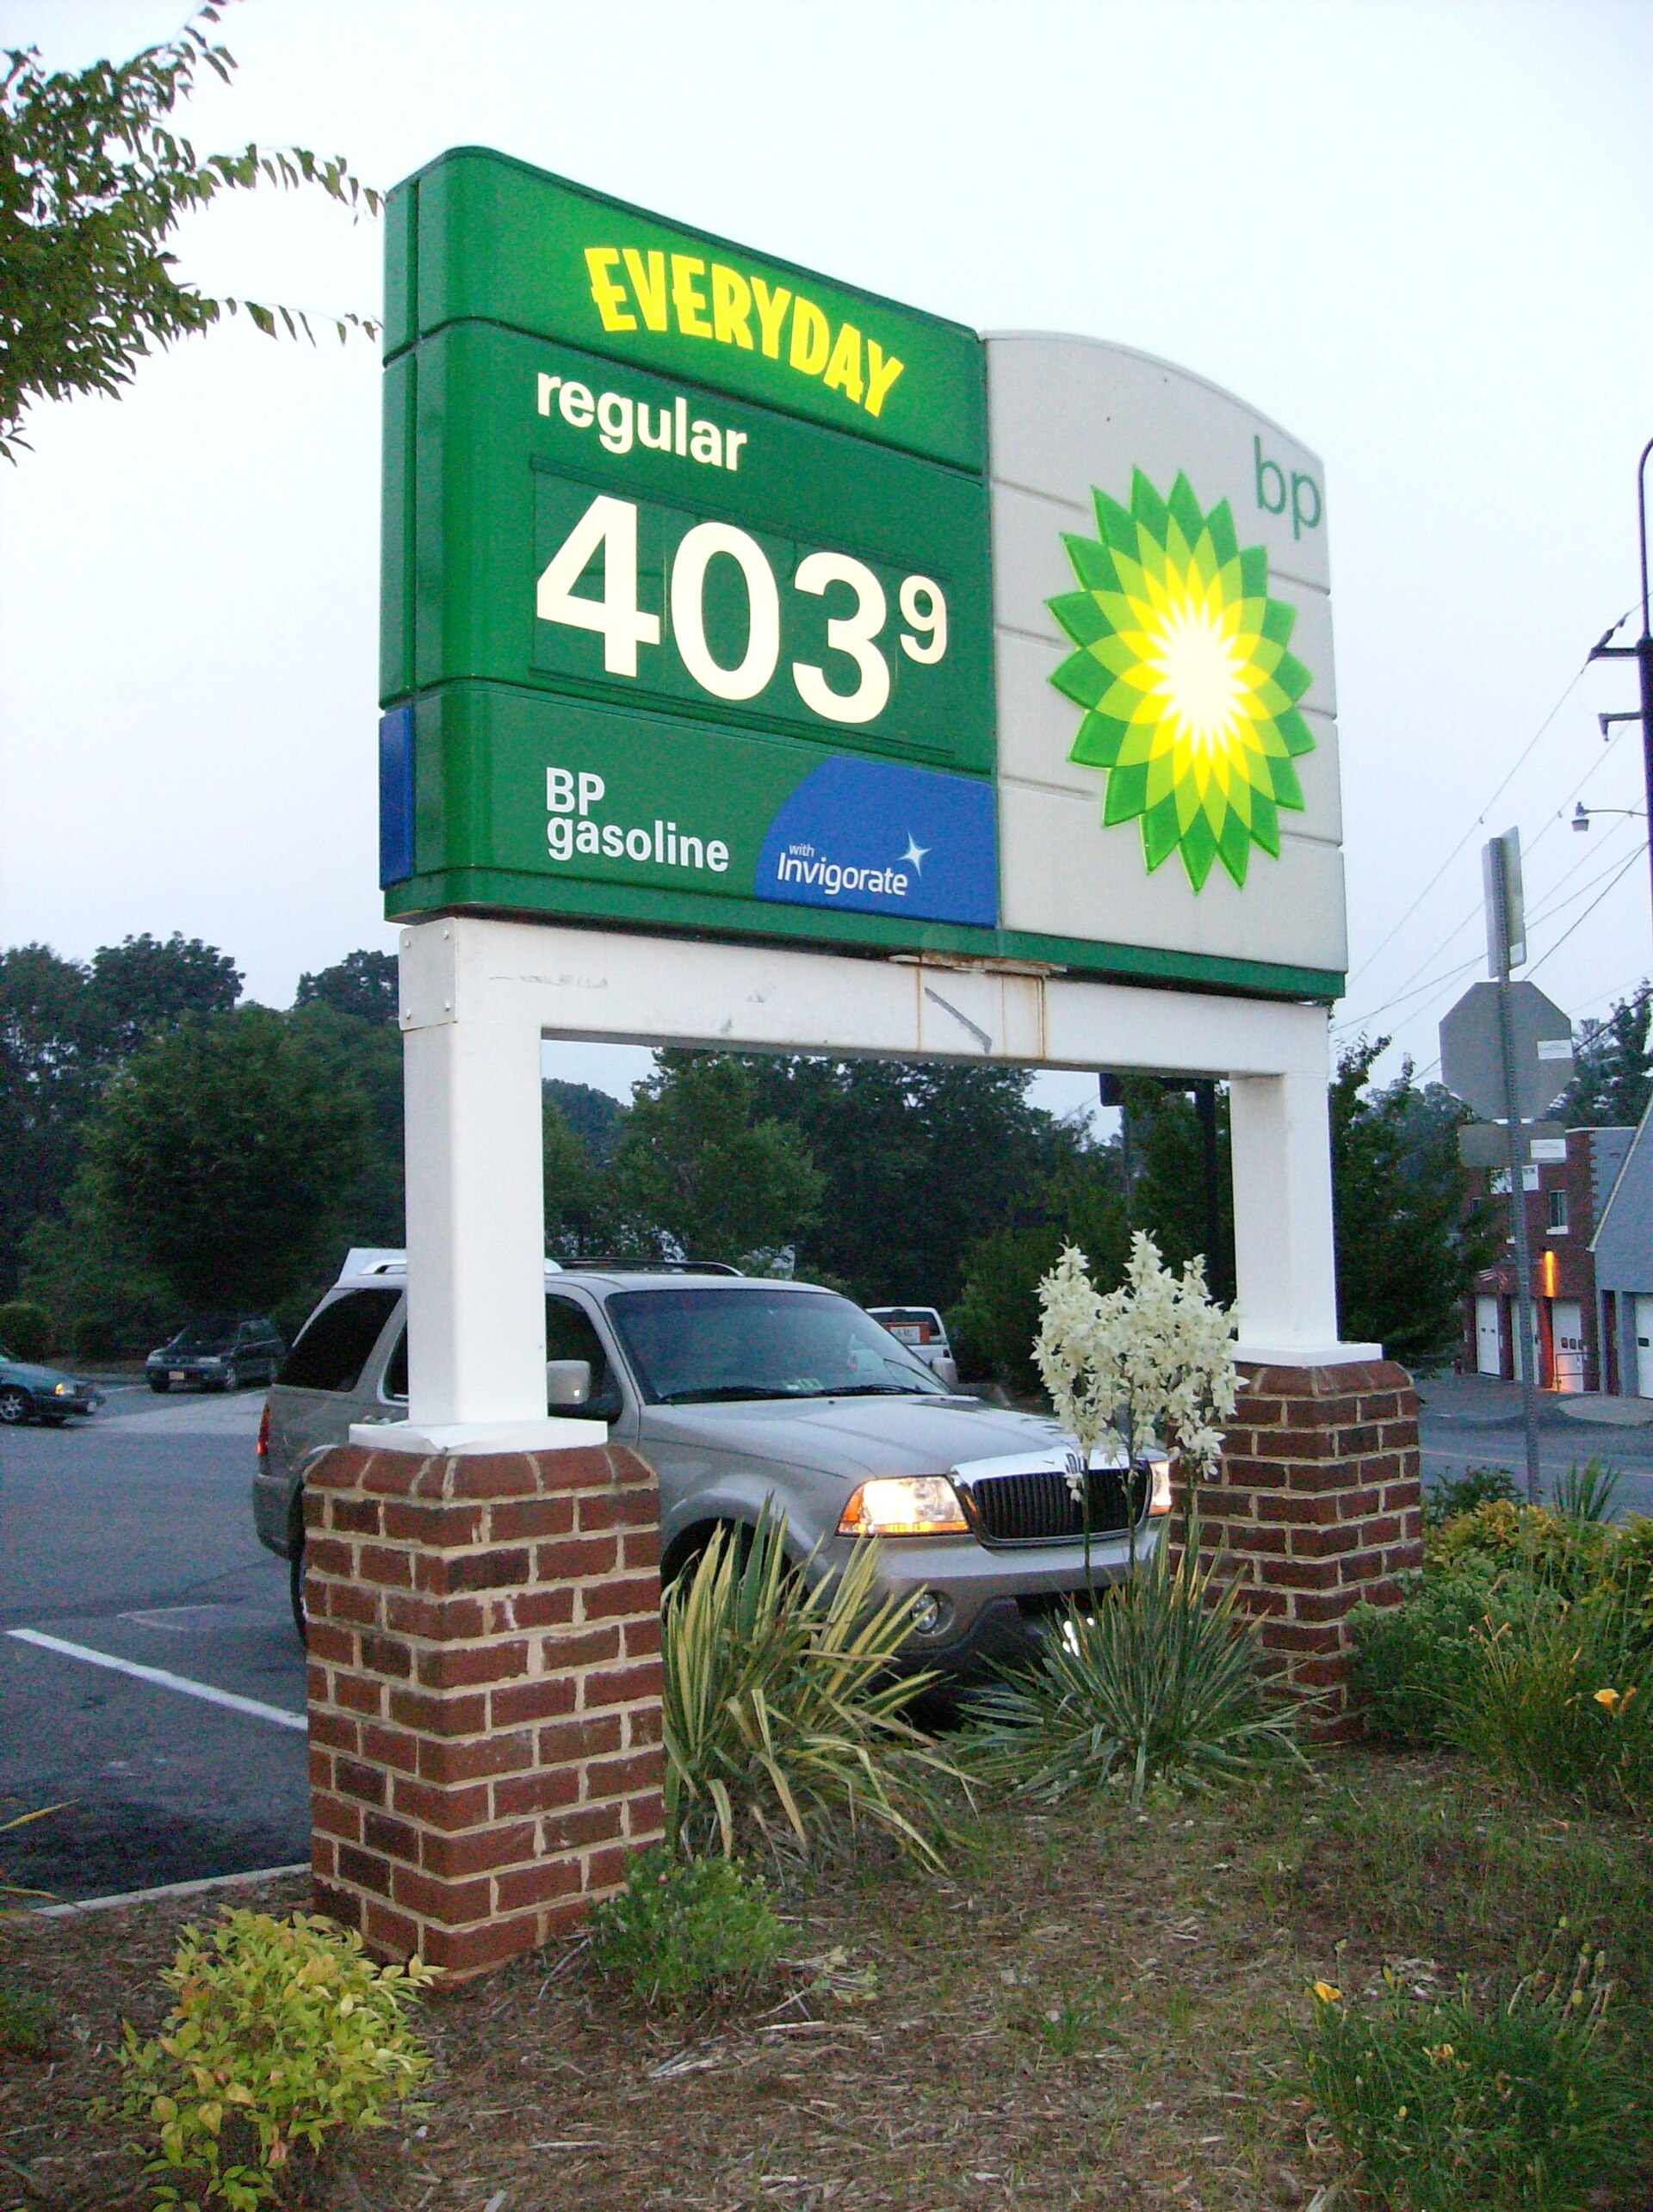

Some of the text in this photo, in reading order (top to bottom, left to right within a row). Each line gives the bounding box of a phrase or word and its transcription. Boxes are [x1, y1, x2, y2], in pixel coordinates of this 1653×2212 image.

[585, 247, 904, 417] EVERYDAY
[536, 372, 747, 472] regular
[1254, 435, 1322, 541] bp
[546, 766, 606, 816] BP
[547, 817, 730, 873] gasoline
[789, 843, 814, 857] with
[777, 851, 908, 896] Invigorate
